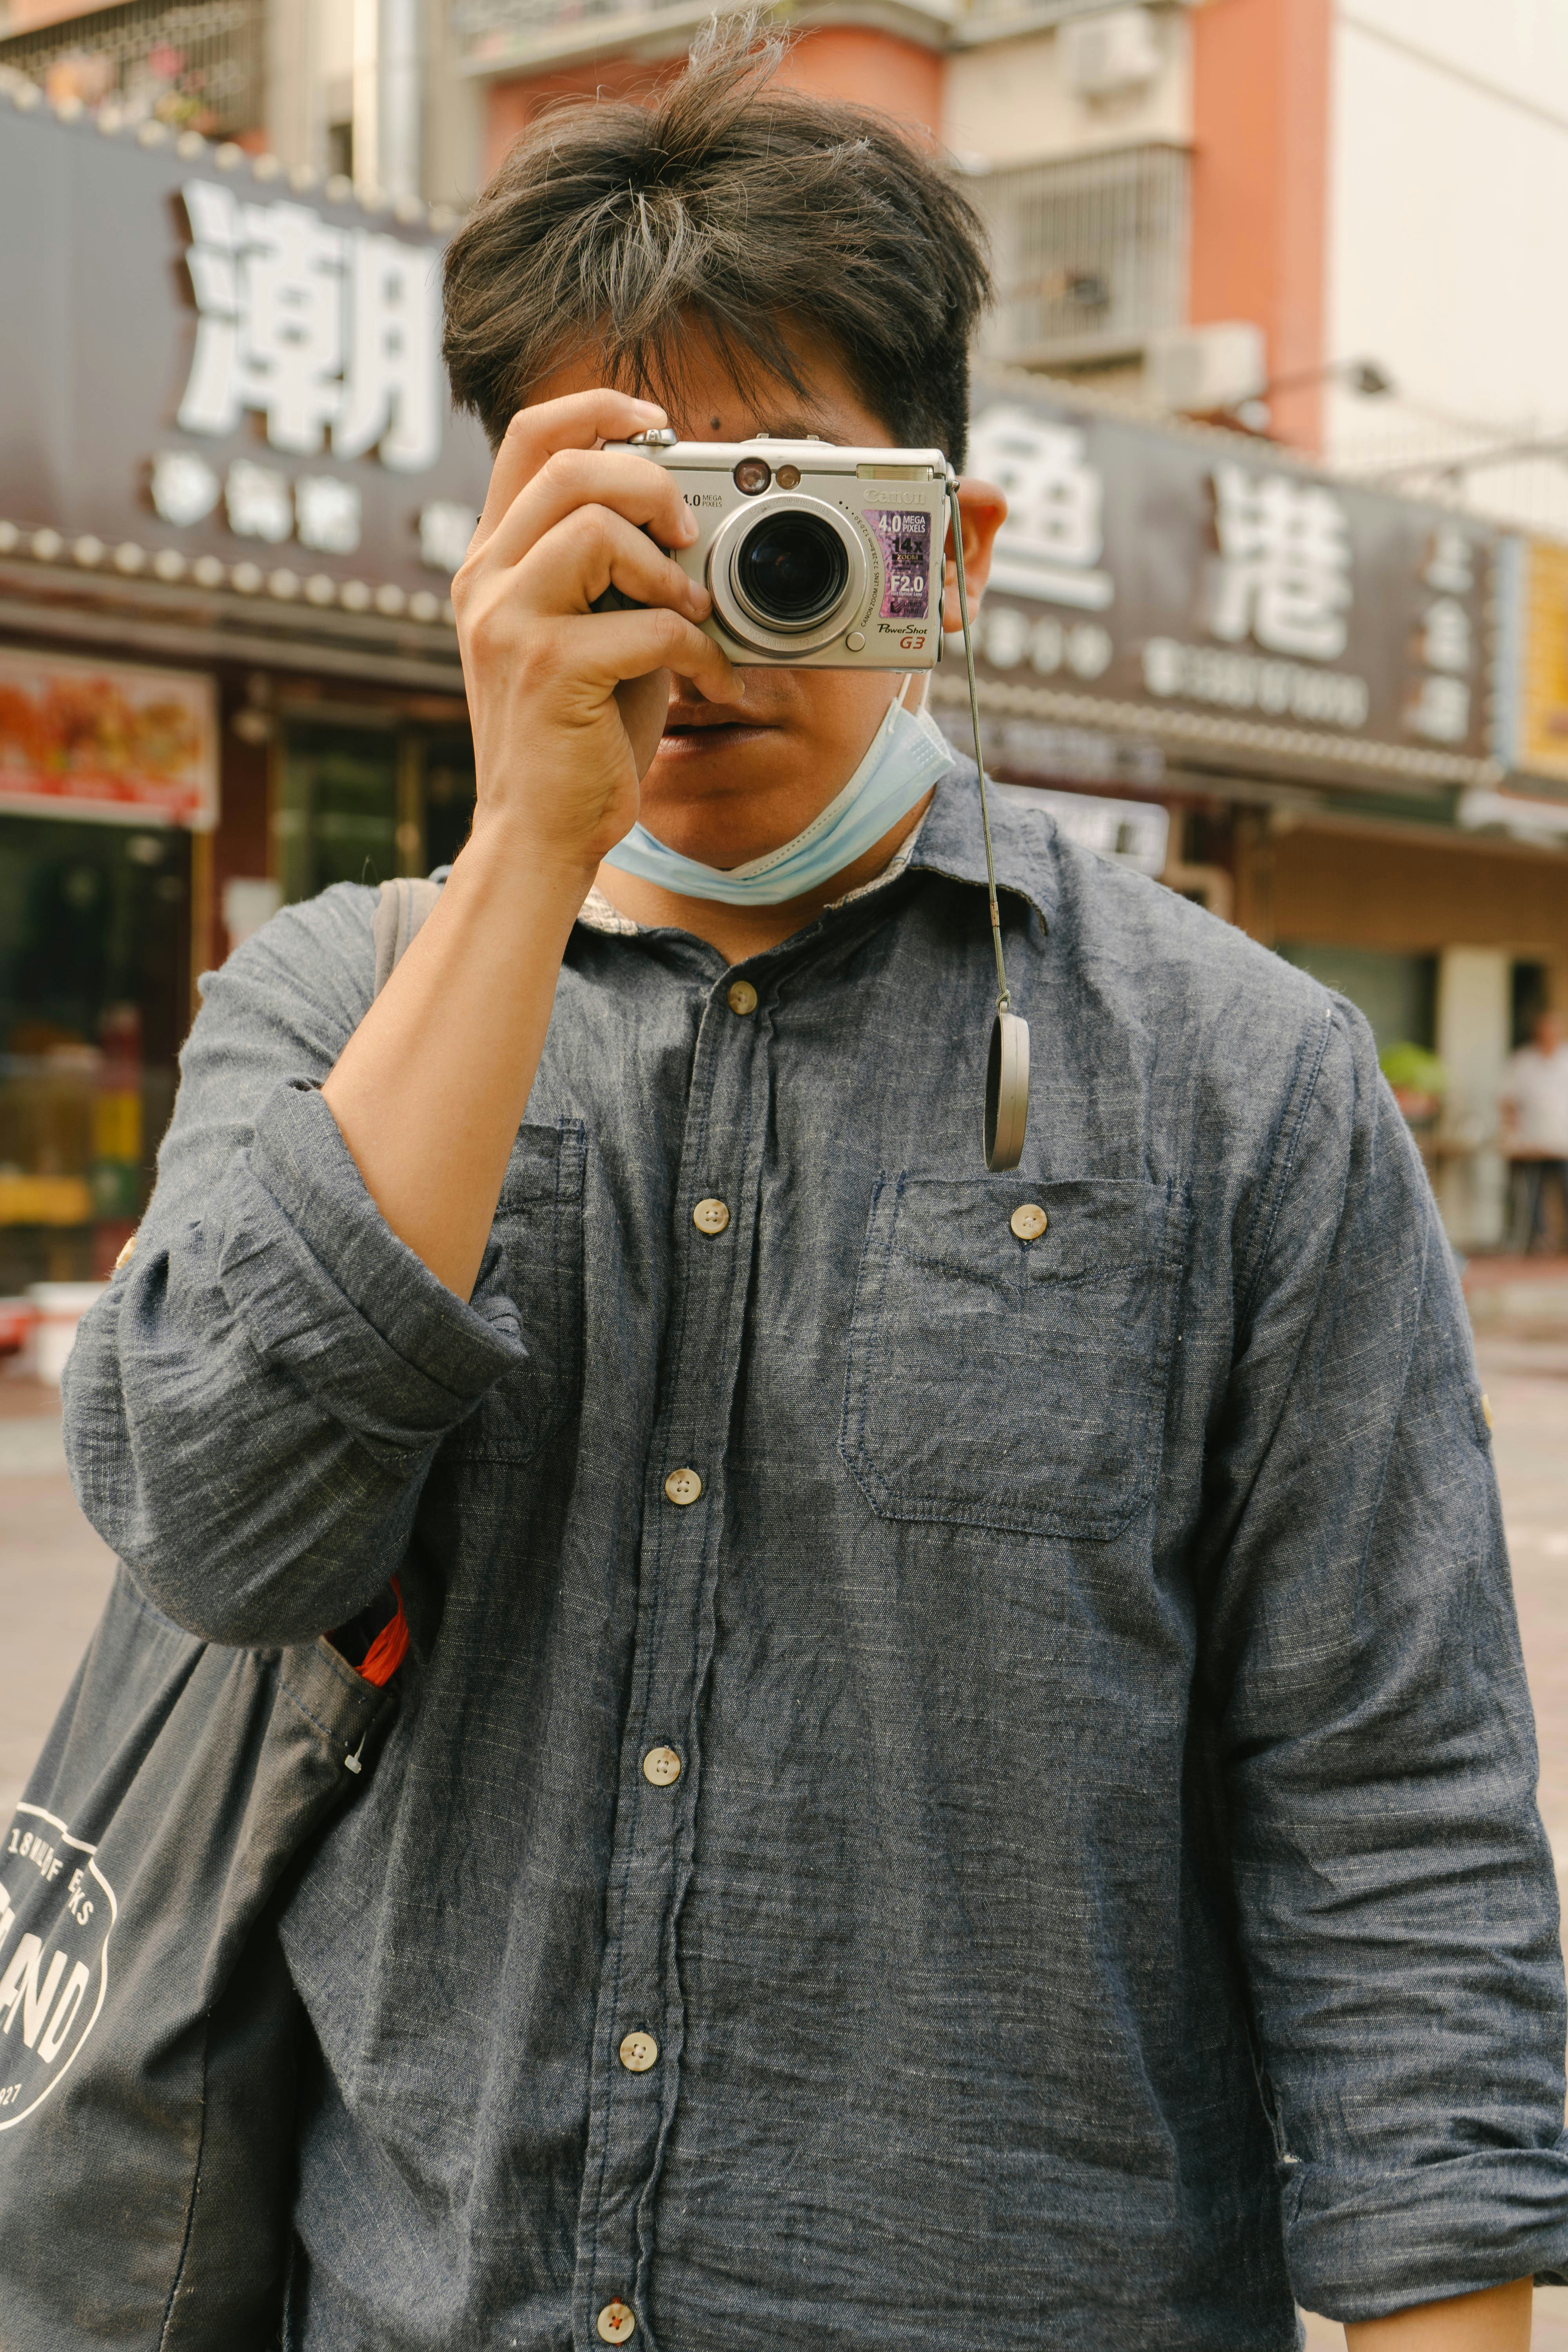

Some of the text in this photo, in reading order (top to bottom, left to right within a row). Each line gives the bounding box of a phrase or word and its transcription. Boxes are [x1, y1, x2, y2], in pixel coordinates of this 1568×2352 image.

[177, 176, 443, 474] 潮
[863, 488, 926, 505] Canon
[878, 514, 926, 532] 4.0 MEGA
[903, 524, 926, 533] PIXELS
[892, 537, 923, 553] 14x
[891, 575, 924, 593] F2.0
[861, 607, 873, 627] CANON
[870, 588, 878, 606] ZOOM
[877, 623, 928, 634] PowerShot
[900, 636, 926, 649] G3
